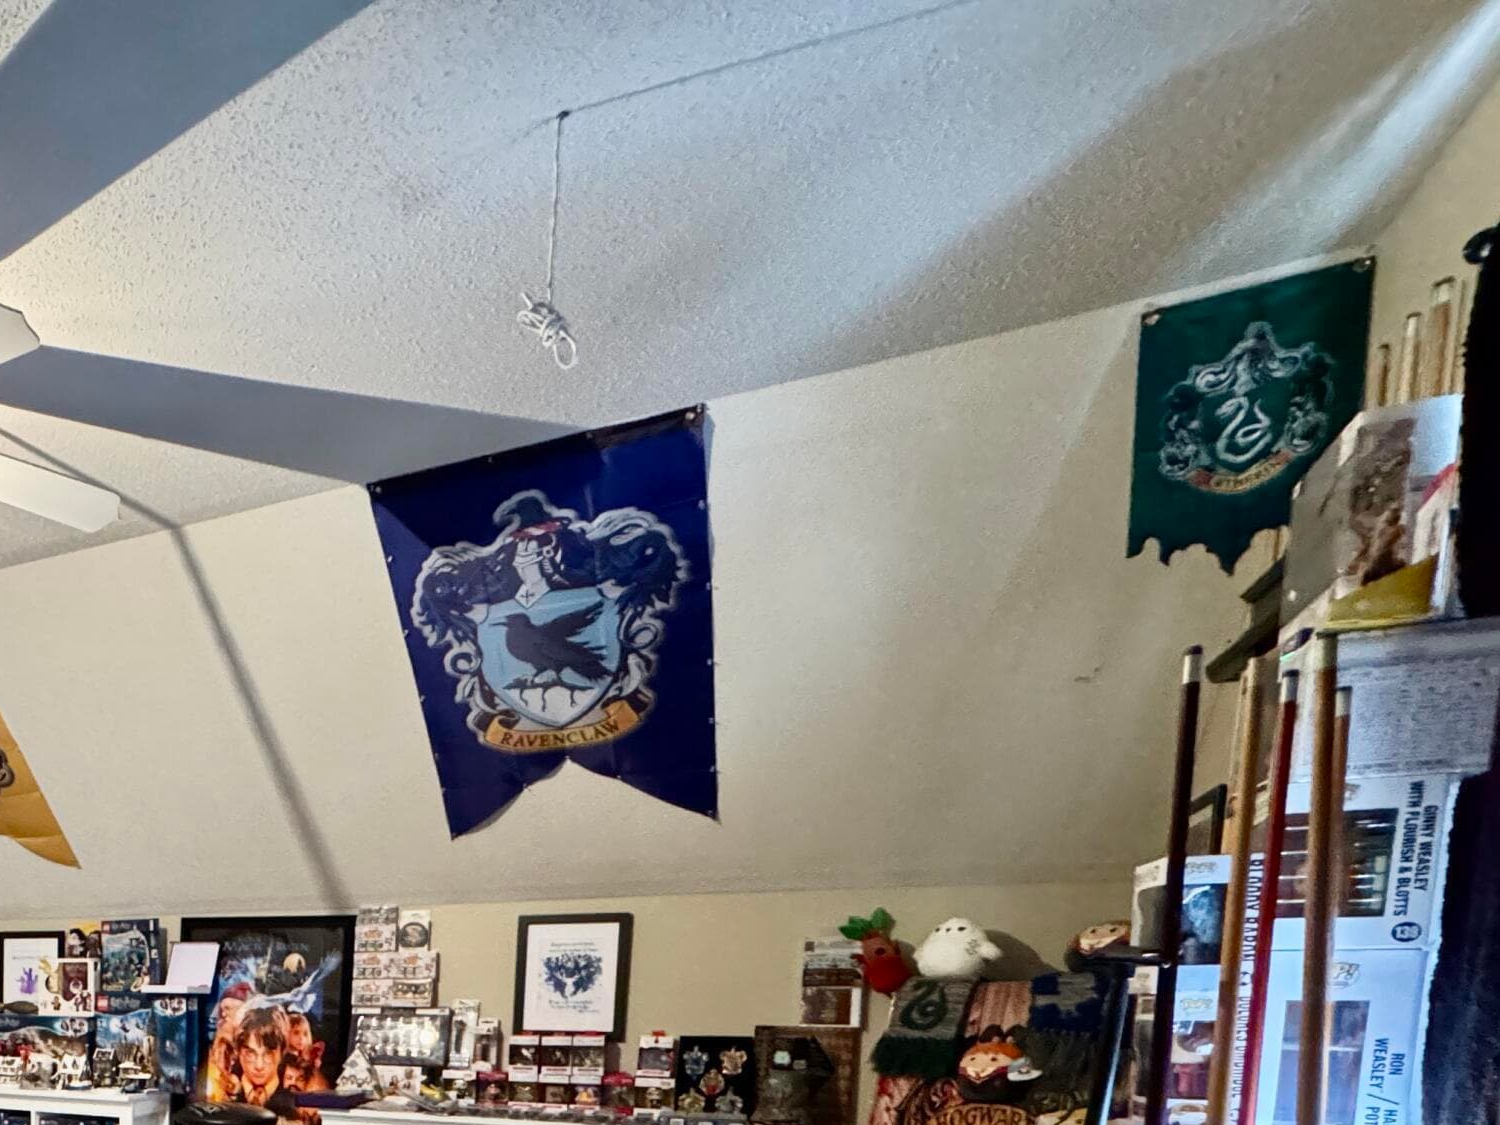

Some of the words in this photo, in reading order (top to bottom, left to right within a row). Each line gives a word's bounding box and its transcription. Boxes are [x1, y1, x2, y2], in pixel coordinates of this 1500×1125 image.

[500, 719, 620, 747] RAVENCLAW
[1406, 780, 1425, 808] WITH
[1400, 811, 1420, 863] FLOURISH
[1422, 805, 1439, 838] GINNY
[1414, 841, 1434, 892] WEASLEY
[1393, 877, 1410, 917] BLOTTS
[1369, 1038, 1389, 1089] WEASLEY
[1389, 1053, 1405, 1076] RON
